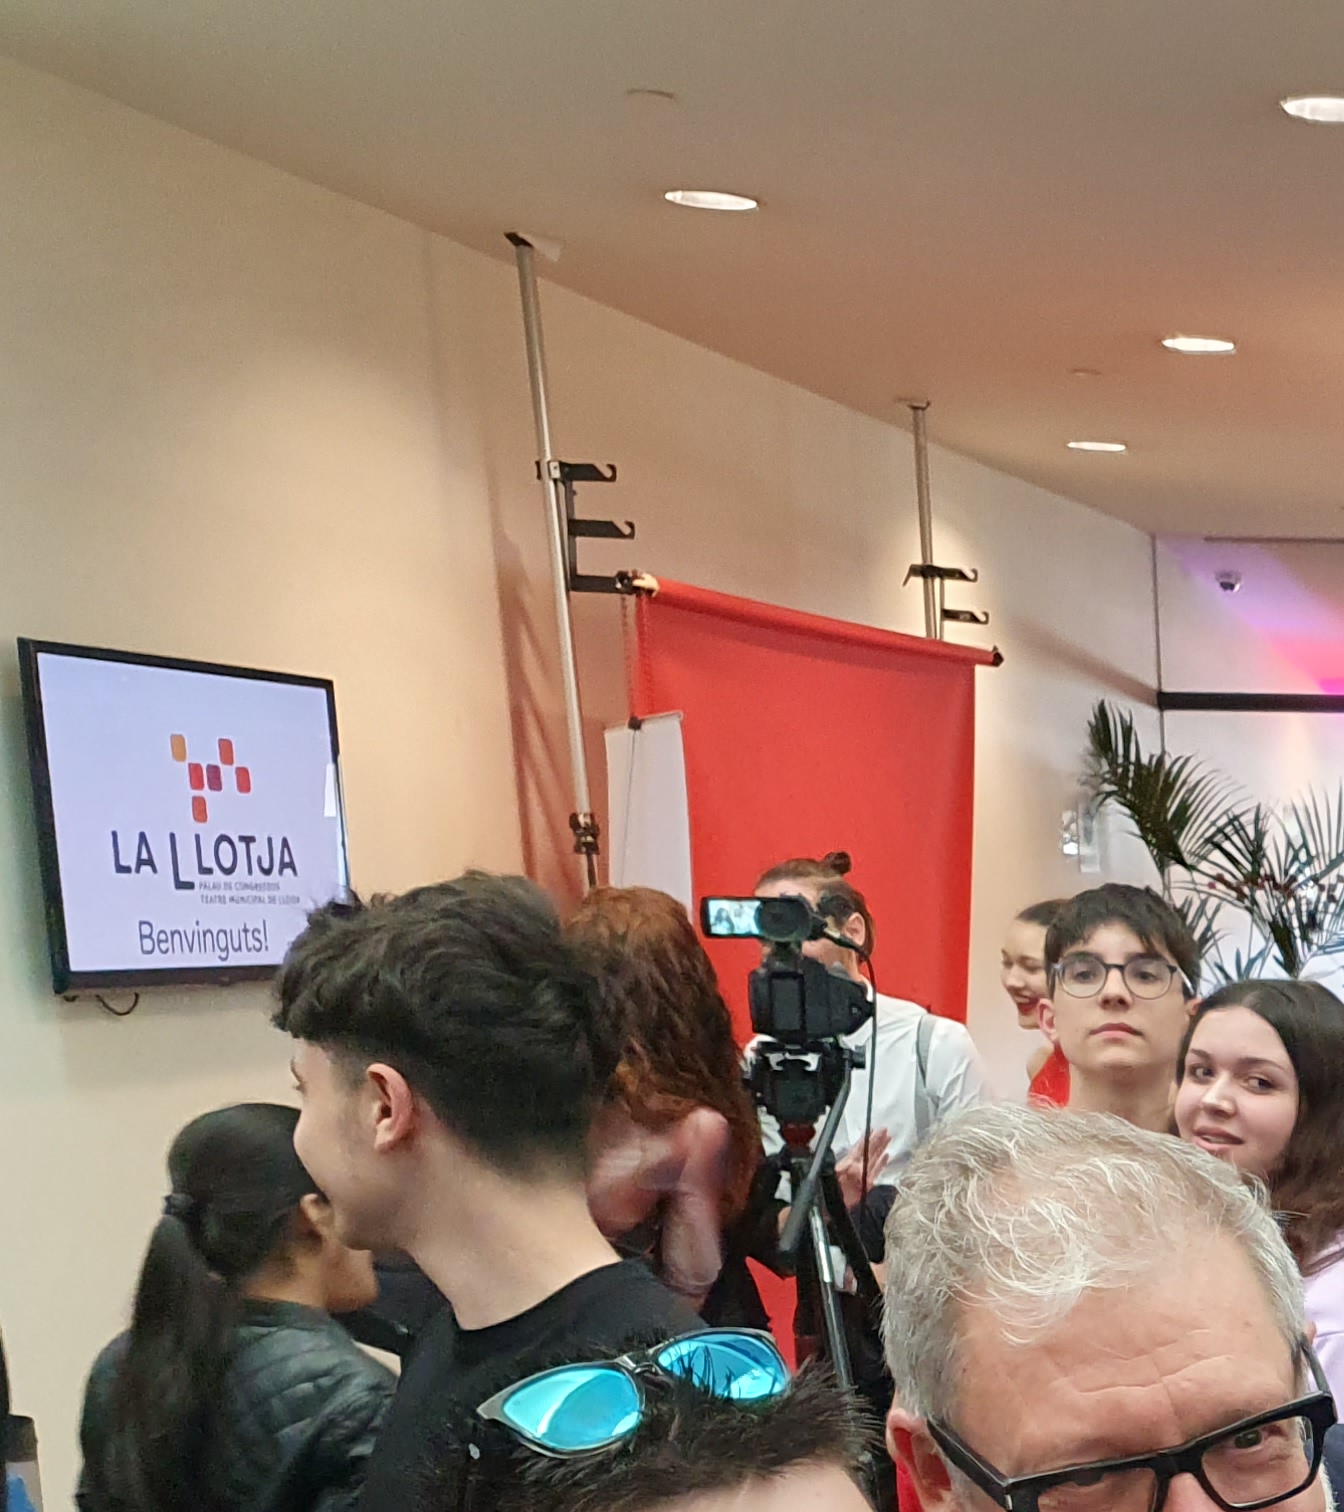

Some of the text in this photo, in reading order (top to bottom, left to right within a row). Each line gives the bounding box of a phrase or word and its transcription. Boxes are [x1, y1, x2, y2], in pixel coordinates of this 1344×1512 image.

[111, 830, 298, 890] LA LLOTJA
[138, 919, 269, 962] Benvinguts!
